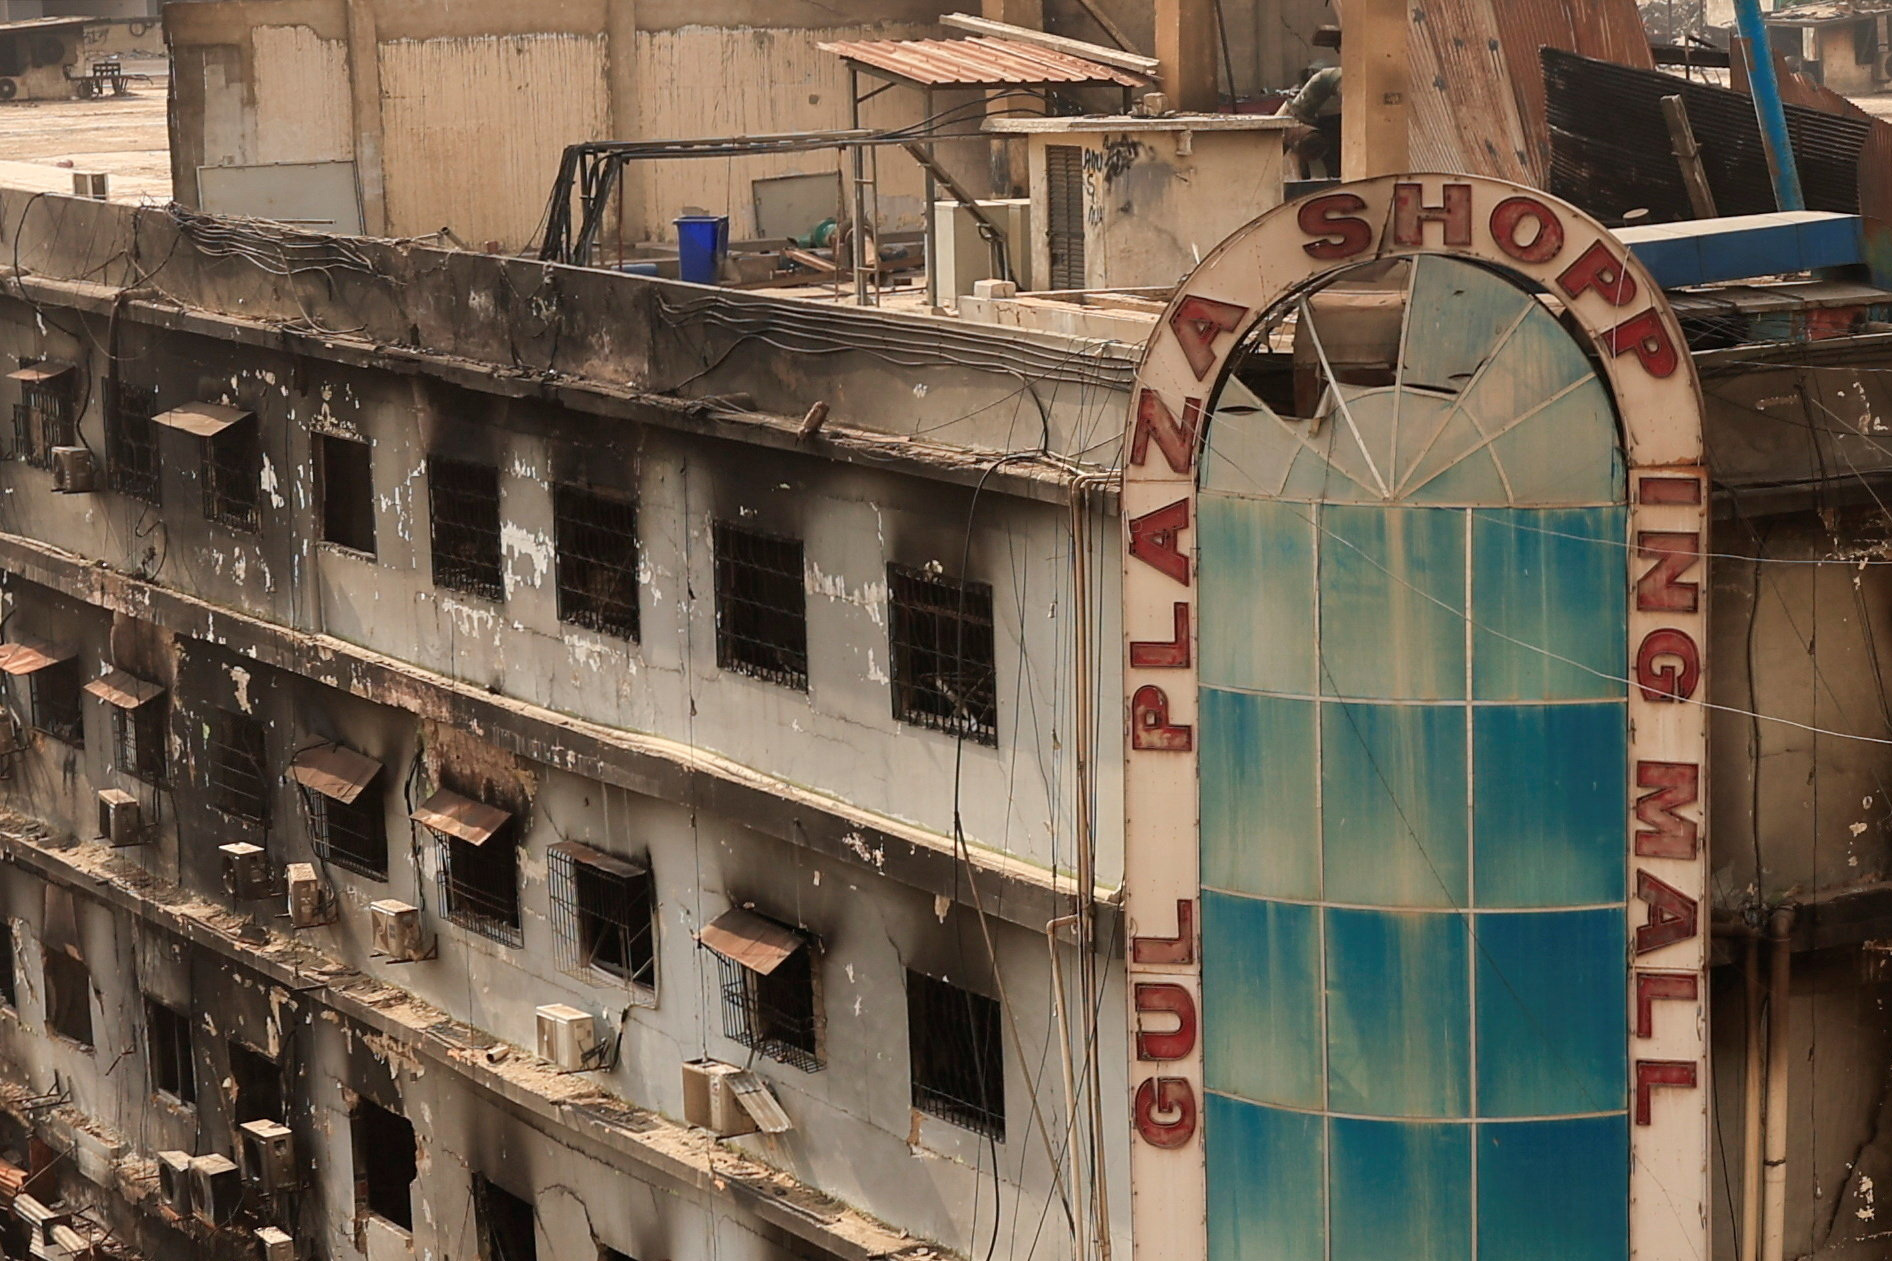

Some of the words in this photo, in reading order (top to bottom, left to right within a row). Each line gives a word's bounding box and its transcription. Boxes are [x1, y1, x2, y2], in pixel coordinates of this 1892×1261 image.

[1128, 293, 1250, 752] PLAZA
[1133, 898, 1197, 1150] GUL
[1634, 760, 1699, 1126] MALL
